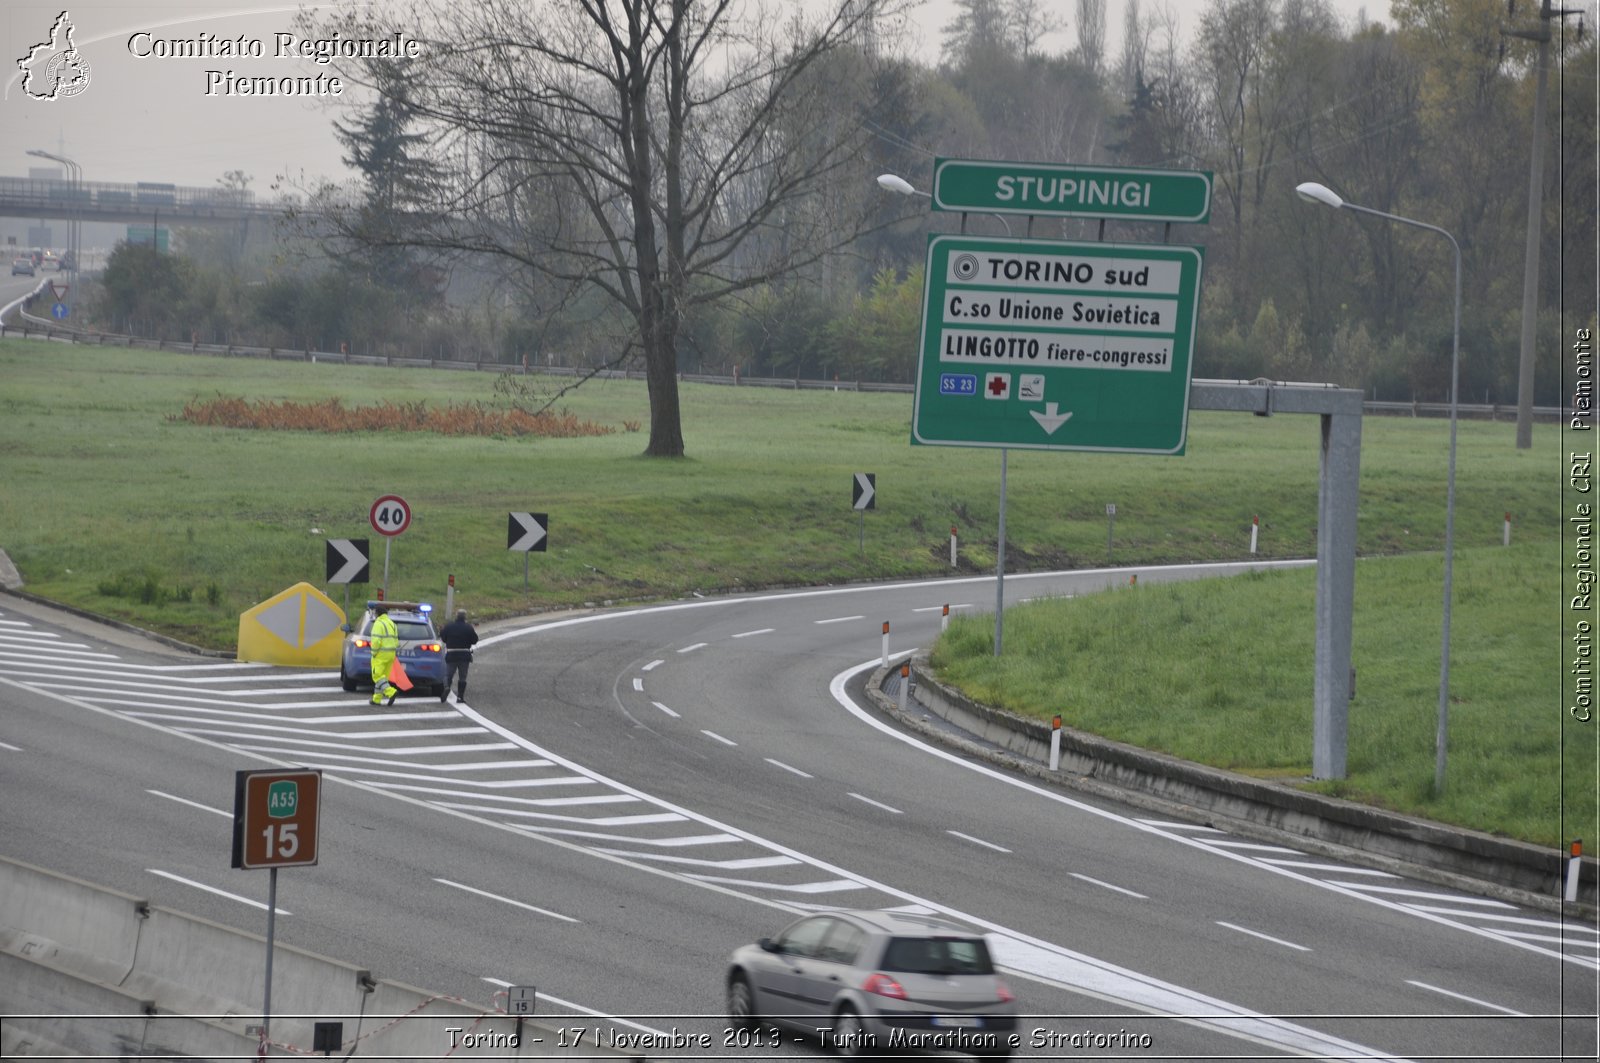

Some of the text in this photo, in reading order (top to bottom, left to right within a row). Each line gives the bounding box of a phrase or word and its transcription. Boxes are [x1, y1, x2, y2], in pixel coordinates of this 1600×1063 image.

[994, 175, 1151, 208] STUPINIGI
[988, 258, 1149, 287] TORINO sud
[949, 296, 1161, 326] C.so Unione Sovietica
[946, 335, 1168, 367] LINGOTTO fiere-congressi
[943, 378, 973, 391] SS 23
[378, 507, 404, 526] 40
[271, 791, 295, 809] A55
[262, 823, 299, 859] 15
[515, 1002, 528, 1012] 15
